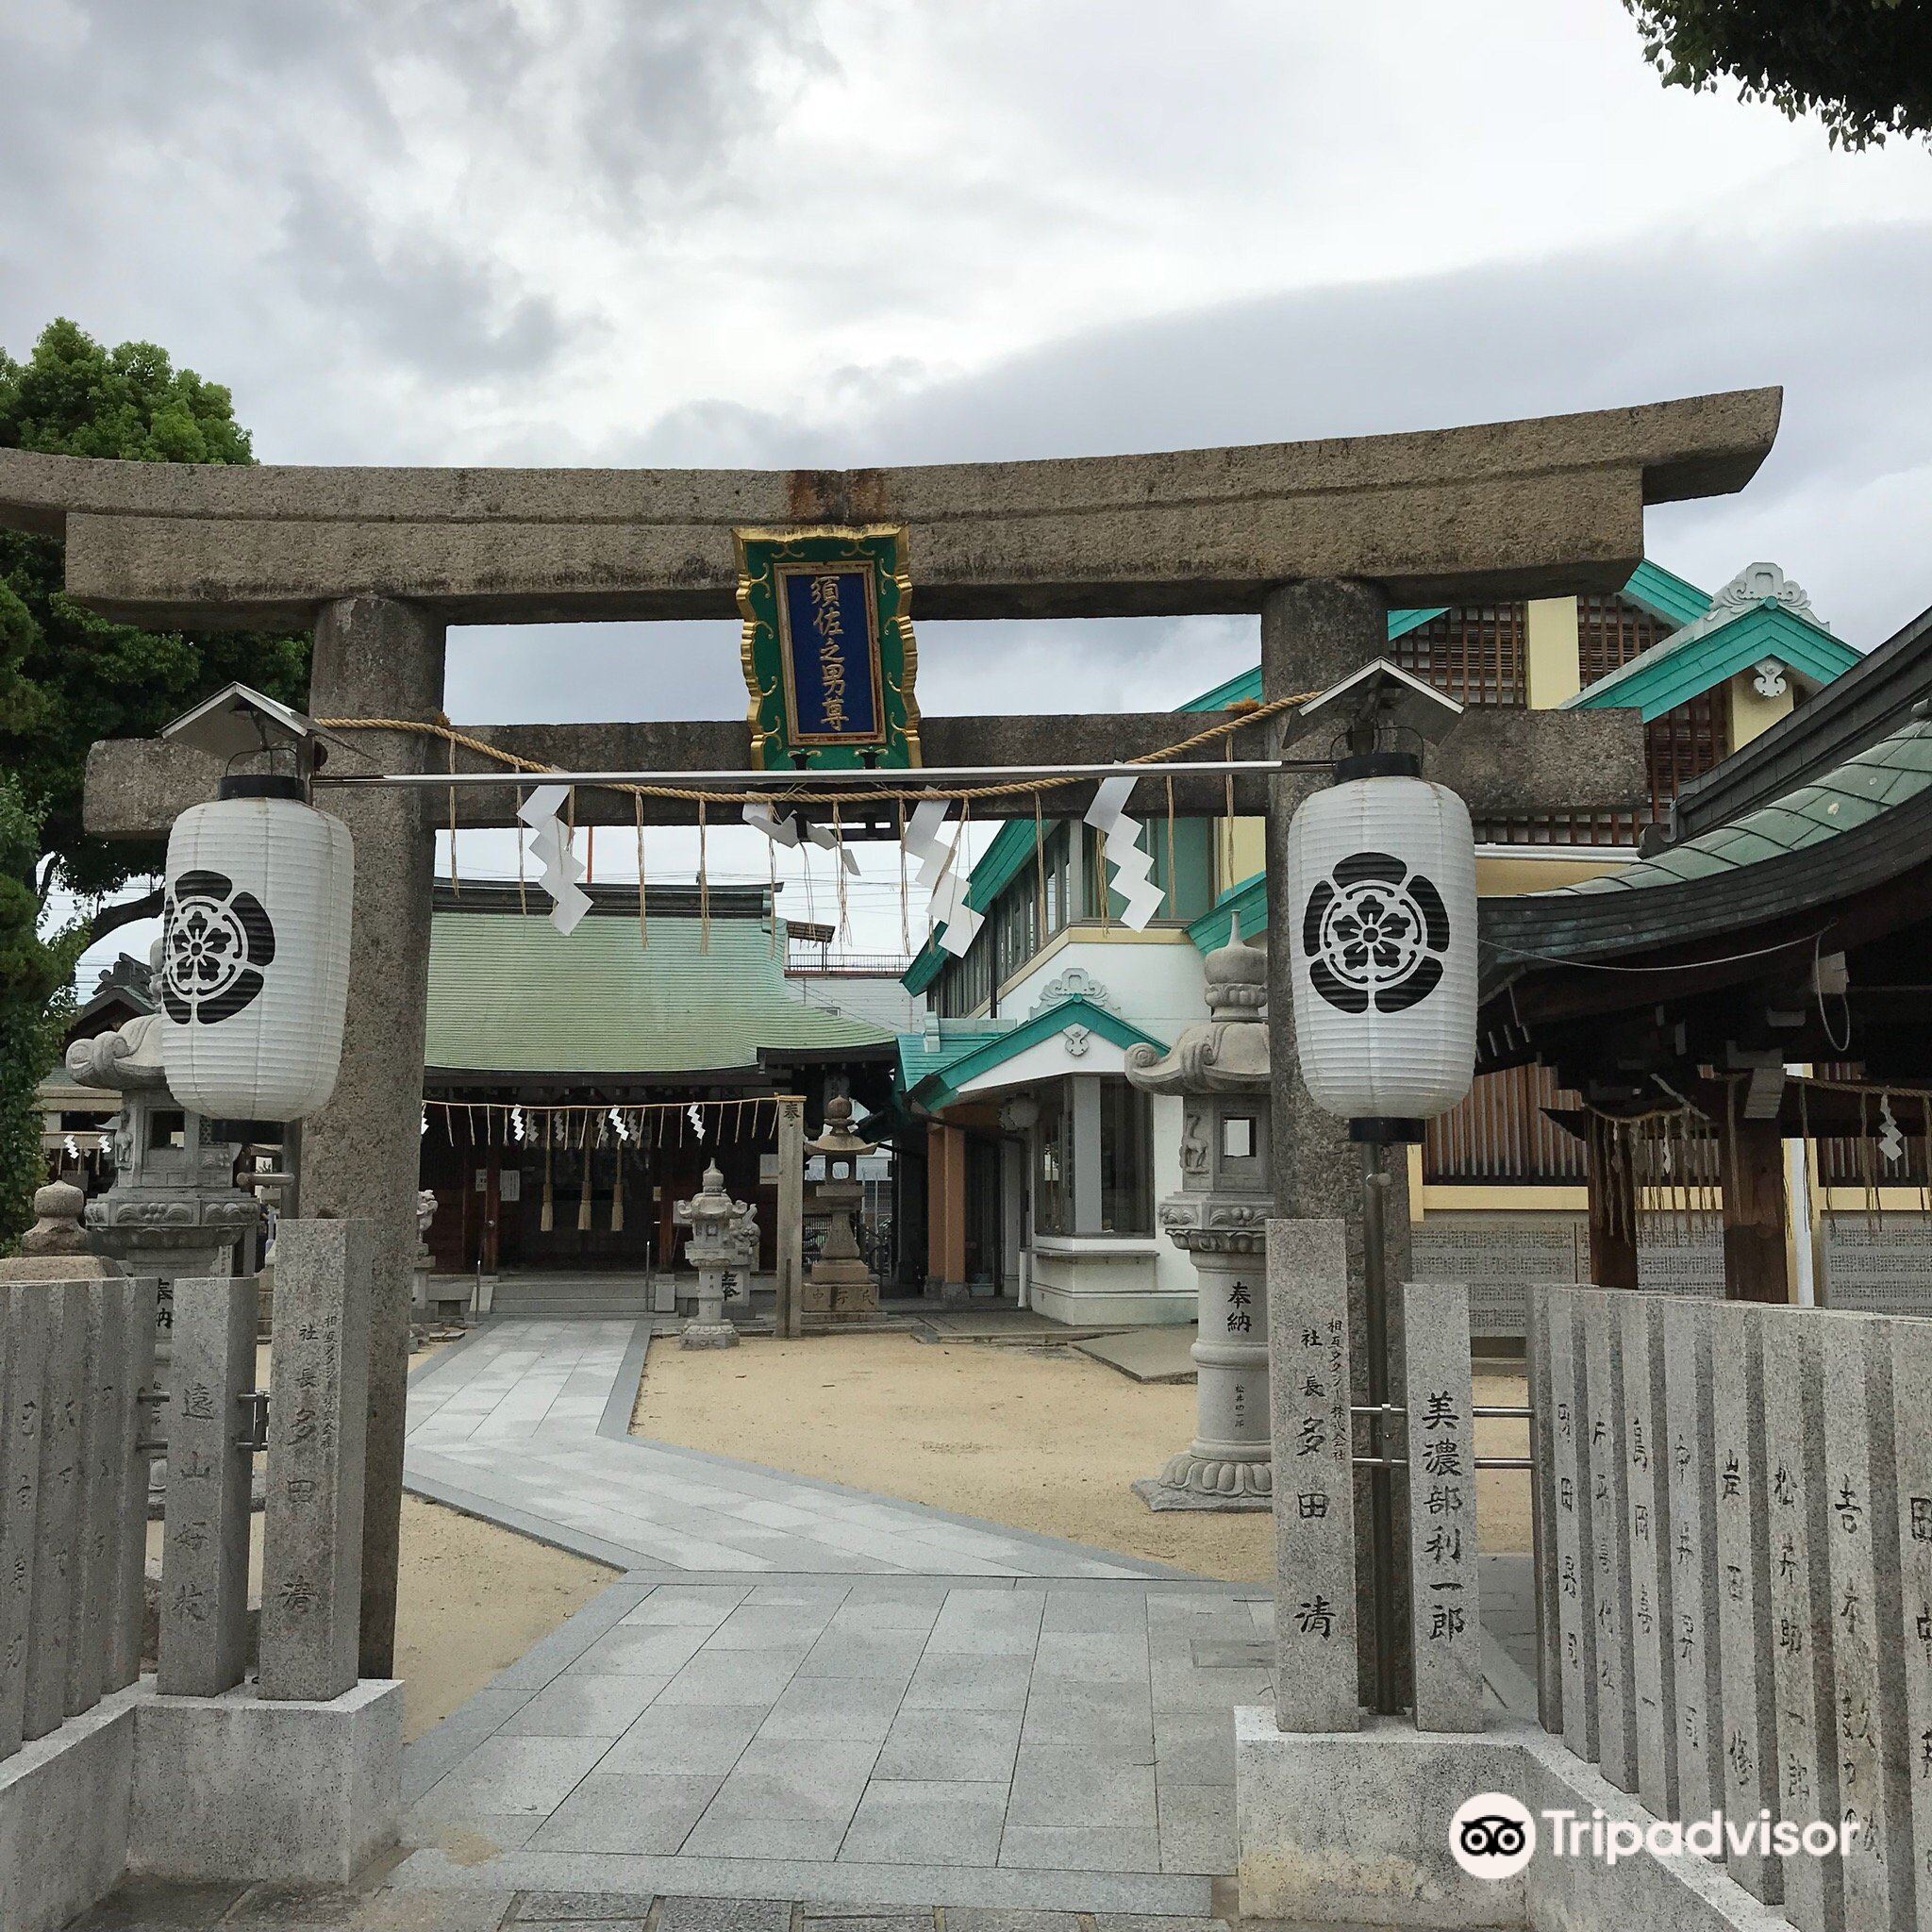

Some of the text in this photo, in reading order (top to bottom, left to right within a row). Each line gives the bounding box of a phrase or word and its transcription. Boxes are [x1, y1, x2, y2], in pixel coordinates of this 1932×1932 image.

[810, 575, 849, 731] 須佐之男尊
[1227, 1281, 1252, 1333] 奉納
[1326, 1318, 1348, 1461] 相互タクシー株式会社
[1293, 1329, 1337, 1641] 社長多田清
[1422, 1391, 1465, 1642] 美濃部利一郎
